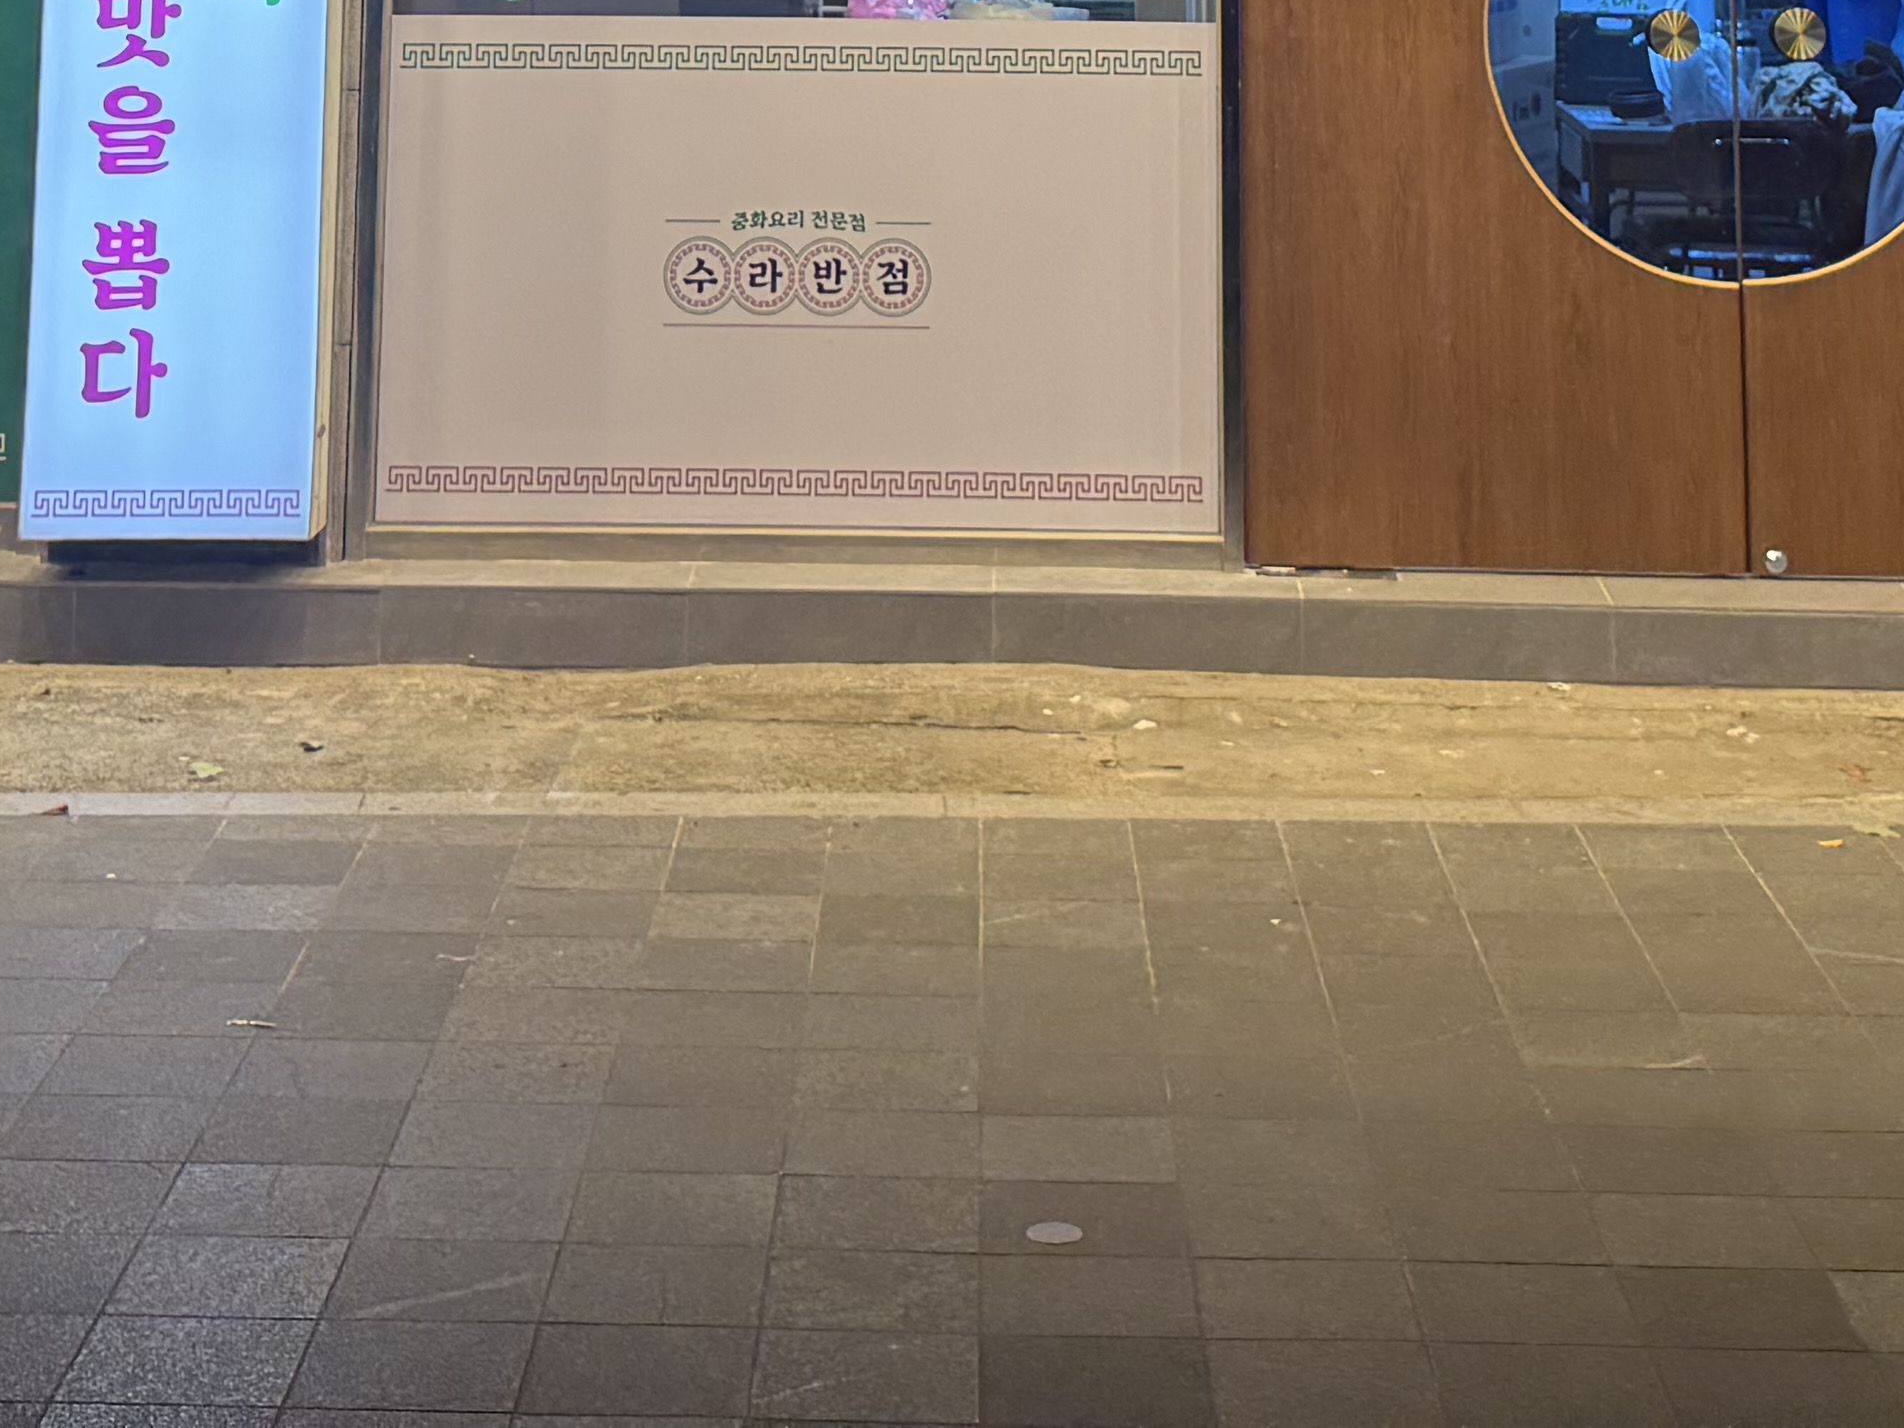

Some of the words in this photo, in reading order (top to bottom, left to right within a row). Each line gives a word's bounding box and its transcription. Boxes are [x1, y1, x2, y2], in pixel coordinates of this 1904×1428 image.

[731, 210, 805, 231] 중화요리
[811, 211, 867, 233] 전문점
[682, 257, 910, 296] 수라반점
[79, 218, 171, 421] 뽑다
